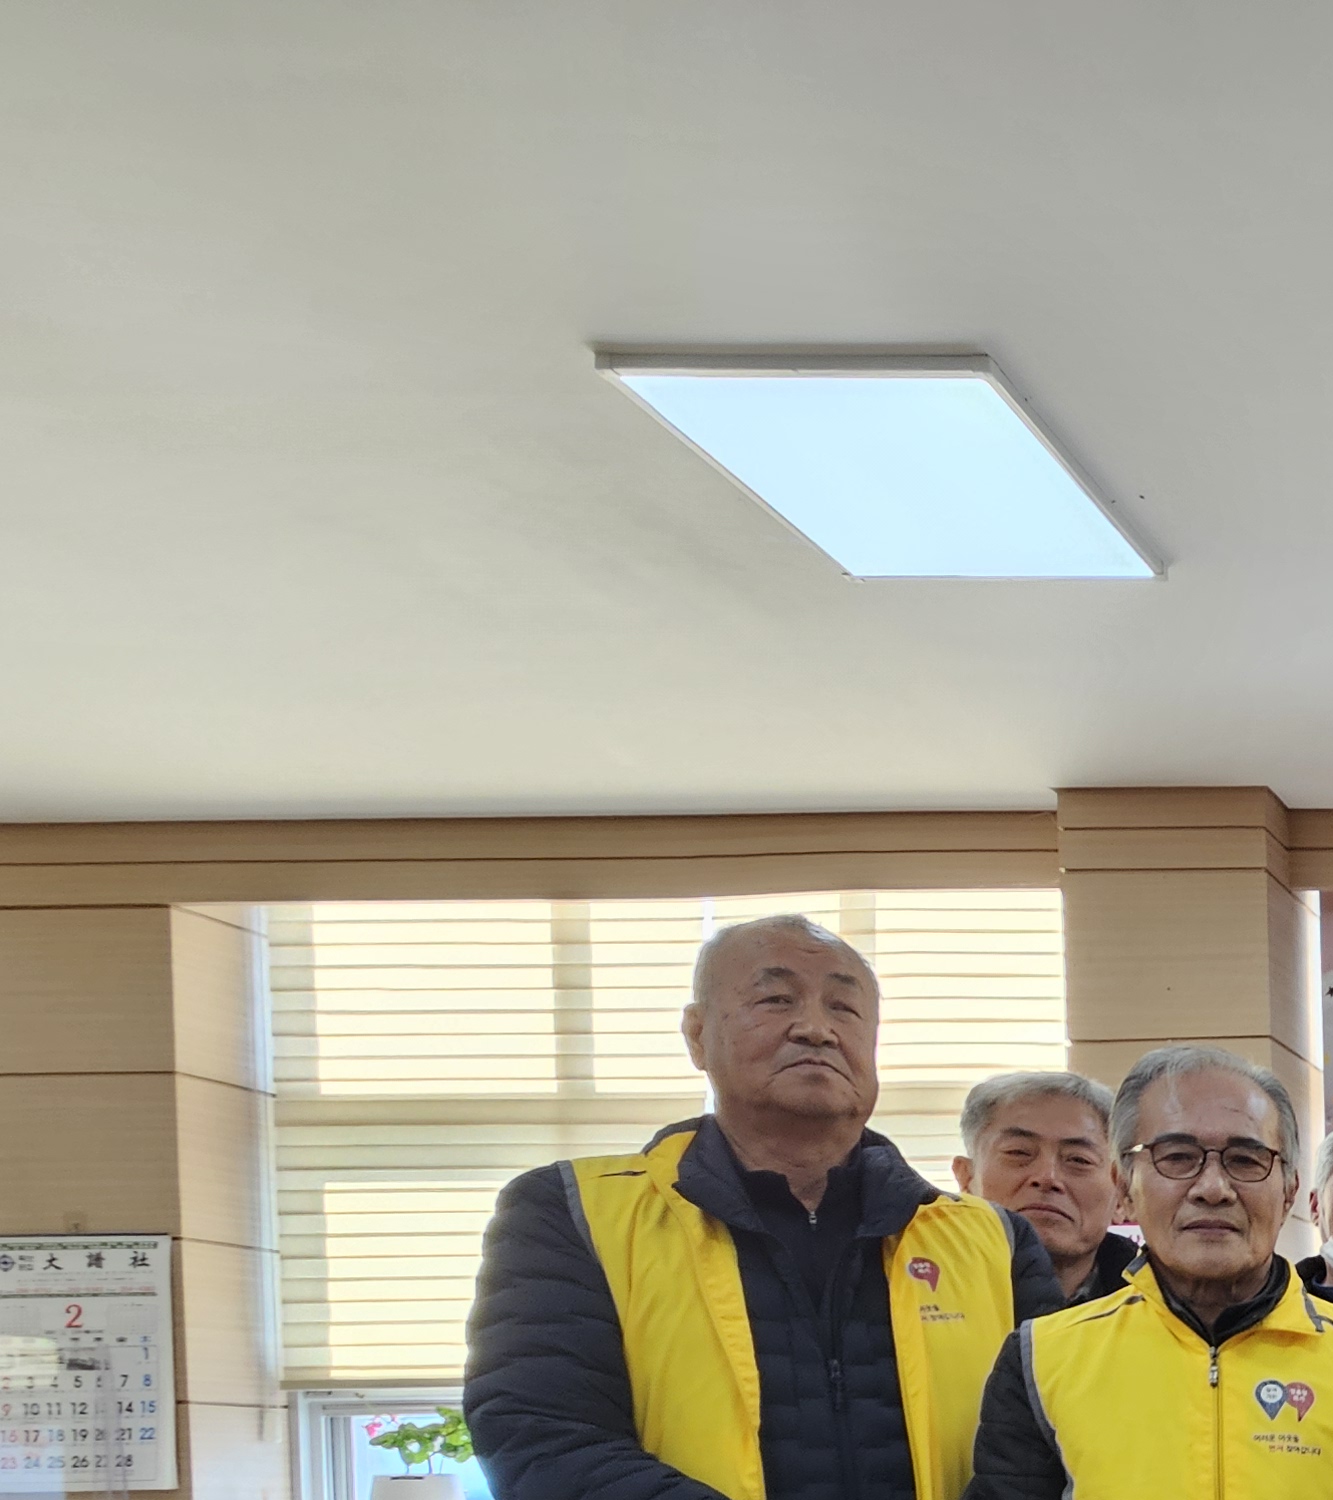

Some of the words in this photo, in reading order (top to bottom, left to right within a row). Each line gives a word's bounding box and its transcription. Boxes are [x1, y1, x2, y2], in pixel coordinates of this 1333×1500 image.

[64, 1304, 83, 1329] 2
[73, 1376, 83, 1388] 5
[119, 1374, 129, 1387] 7
[143, 1374, 152, 1387] 8
[2, 1403, 12, 1416] 9
[23, 1403, 40, 1416] 10
[46, 1402, 62, 1416] 11
[70, 1402, 89, 1415] 12
[117, 1401, 134, 1413] 14
[140, 1400, 156, 1413] 15
[24, 1429, 40, 1442] 17
[72, 1428, 89, 1441] 19
[115, 1427, 133, 1441] 21
[139, 1427, 156, 1440] 22
[23, 1456, 41, 1469] 24
[47, 1456, 65, 1468] 25
[71, 1455, 89, 1468] 26
[115, 1454, 133, 1467] 28
